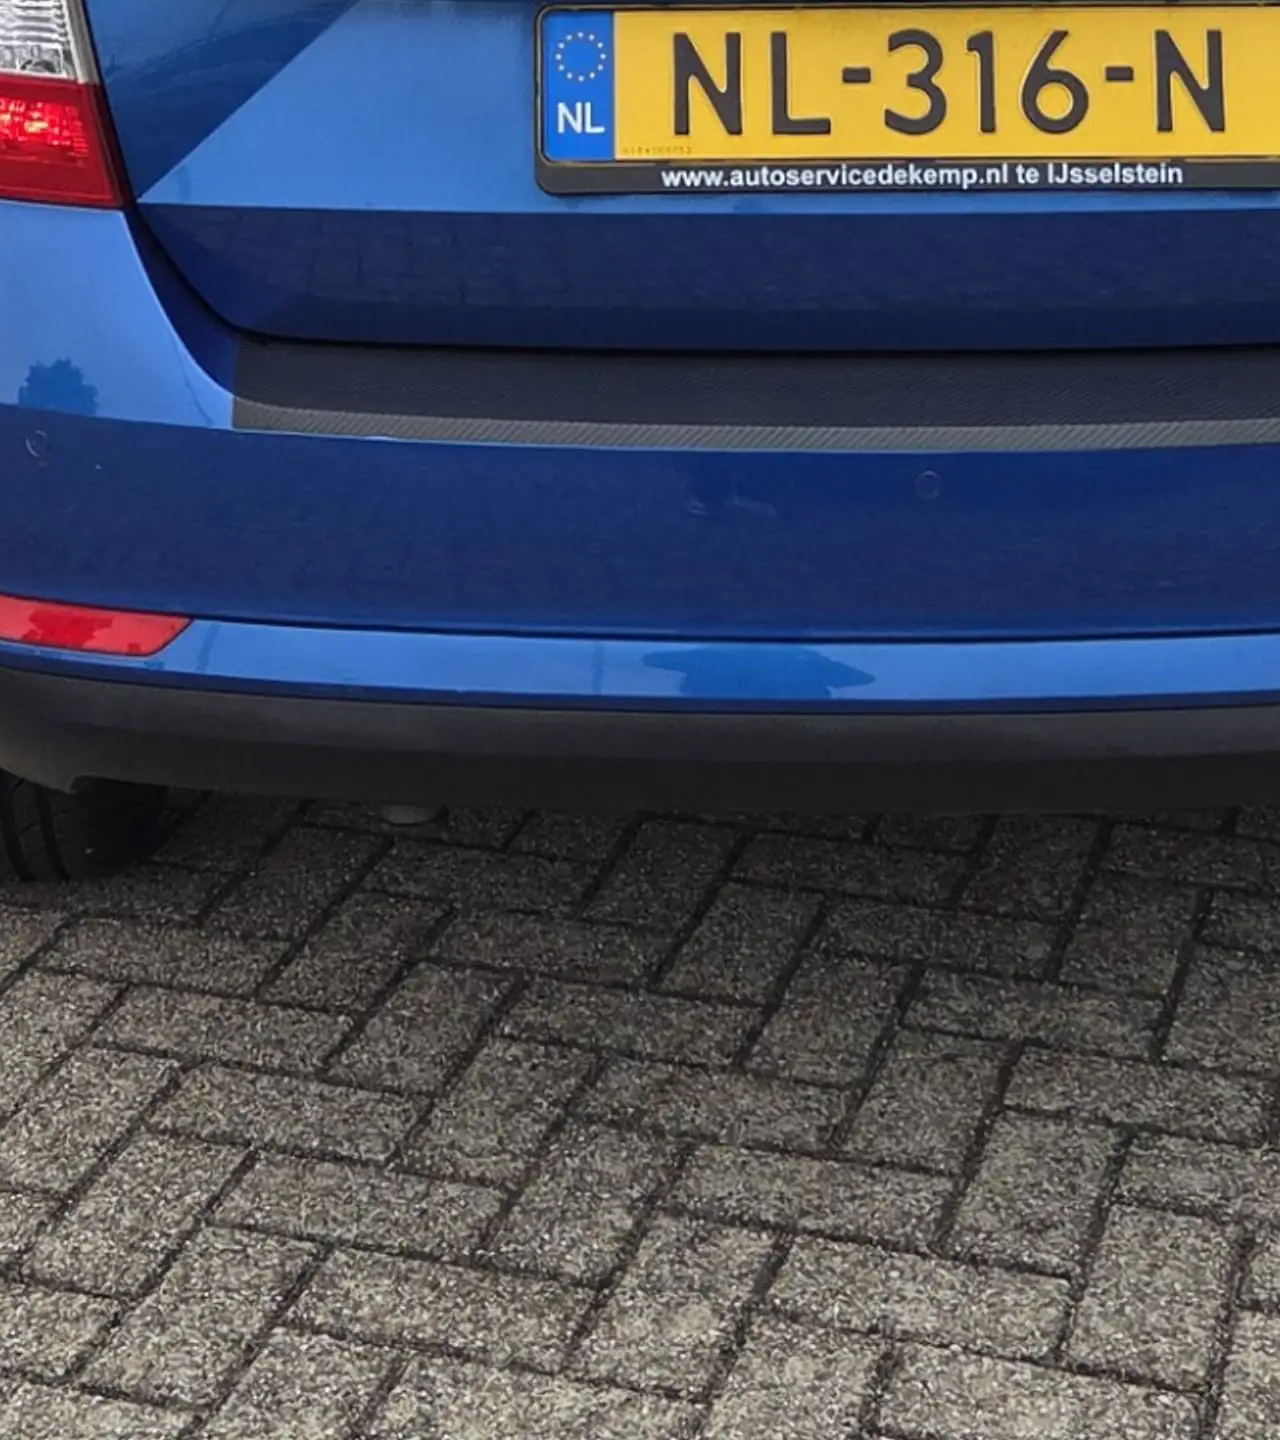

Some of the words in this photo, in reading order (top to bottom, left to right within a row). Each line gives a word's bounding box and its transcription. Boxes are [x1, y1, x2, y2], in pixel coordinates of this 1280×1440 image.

[557, 101, 605, 134] NL
[672, 29, 1226, 136] NL-316-N
[660, 163, 1008, 190] www.autoservicedekemp.nl
[1015, 164, 1040, 185] te
[1047, 161, 1184, 186] IJsselstein
